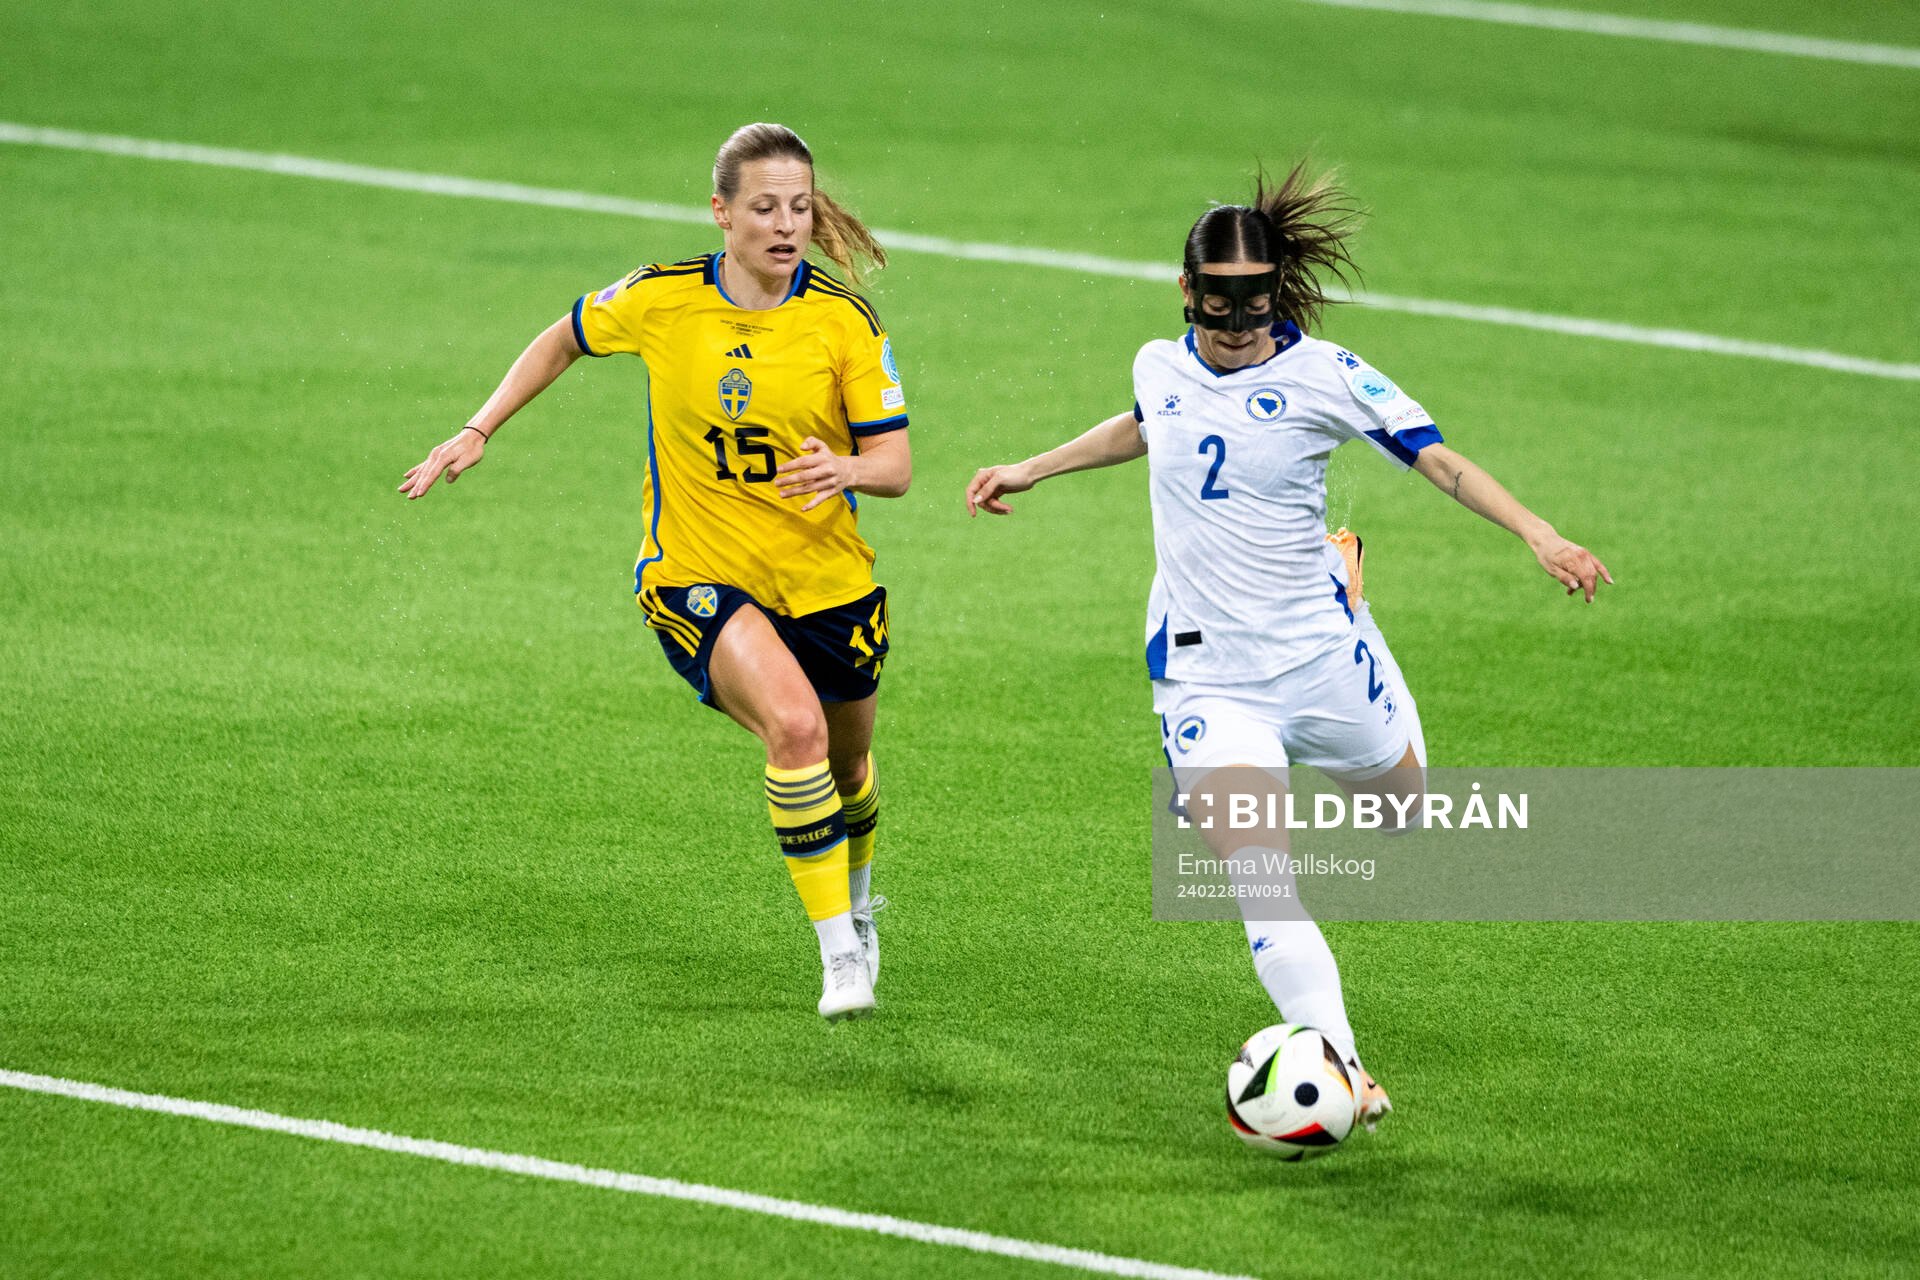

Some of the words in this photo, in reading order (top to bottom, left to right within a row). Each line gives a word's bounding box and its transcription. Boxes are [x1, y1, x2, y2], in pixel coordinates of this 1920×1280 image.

[703, 426, 777, 483] 15
[1198, 434, 1229, 500] 2
[1354, 639, 1384, 703] 2
